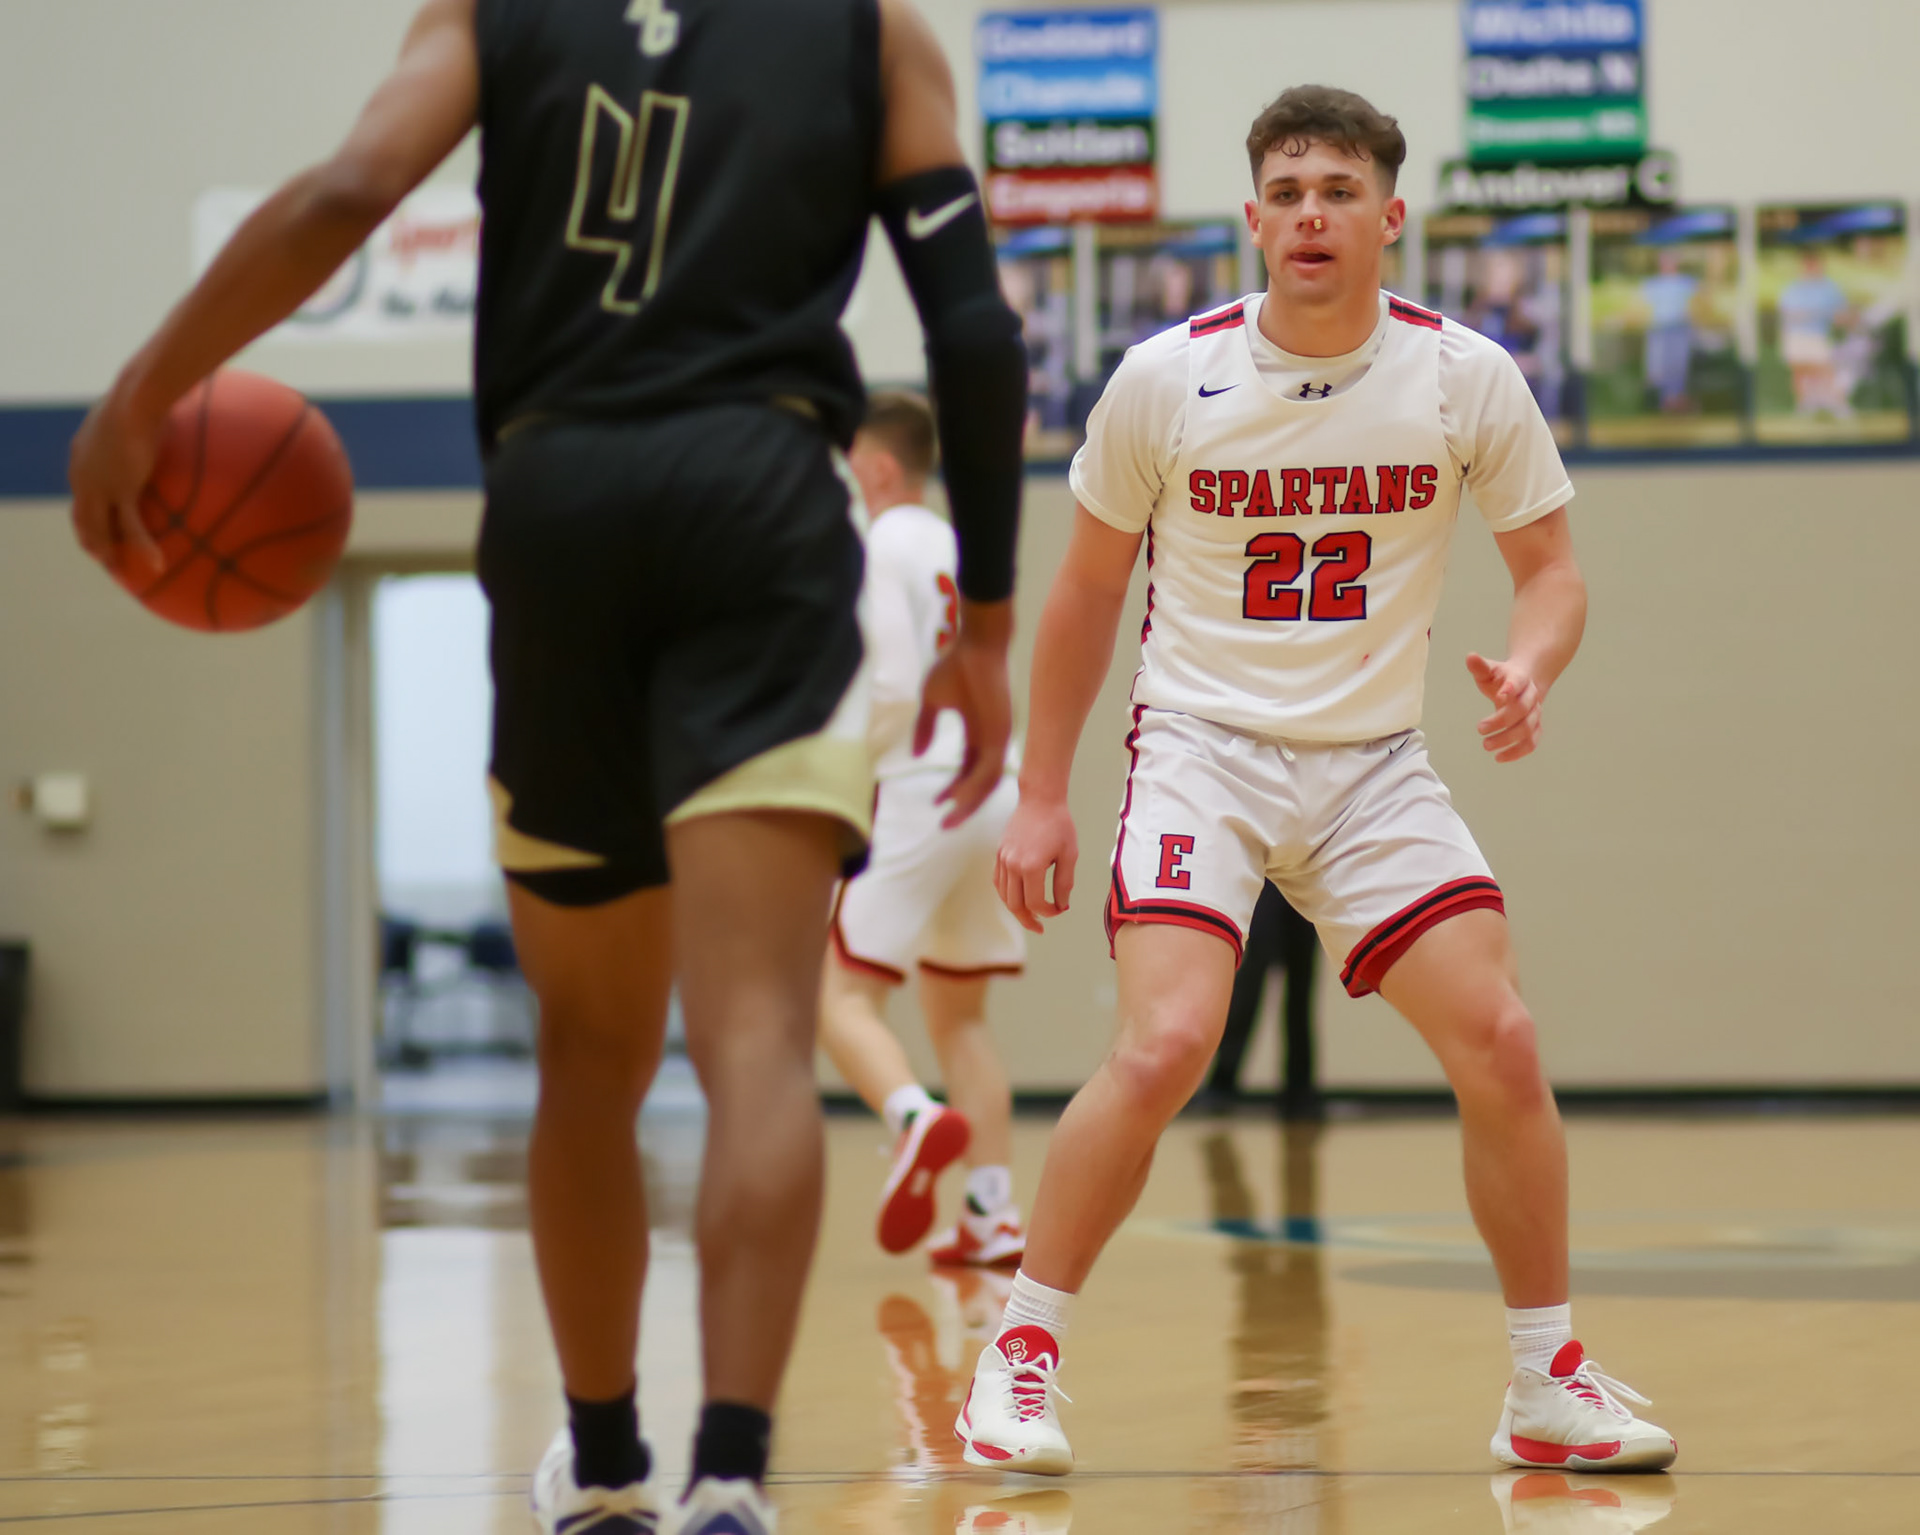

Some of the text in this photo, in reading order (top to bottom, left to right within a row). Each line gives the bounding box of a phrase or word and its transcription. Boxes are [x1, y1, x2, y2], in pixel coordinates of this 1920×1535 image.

[565, 82, 690, 315] 4
[1189, 464, 1438, 517] SPARTANS
[1242, 530, 1372, 621] 22
[1155, 833, 1195, 890] E
